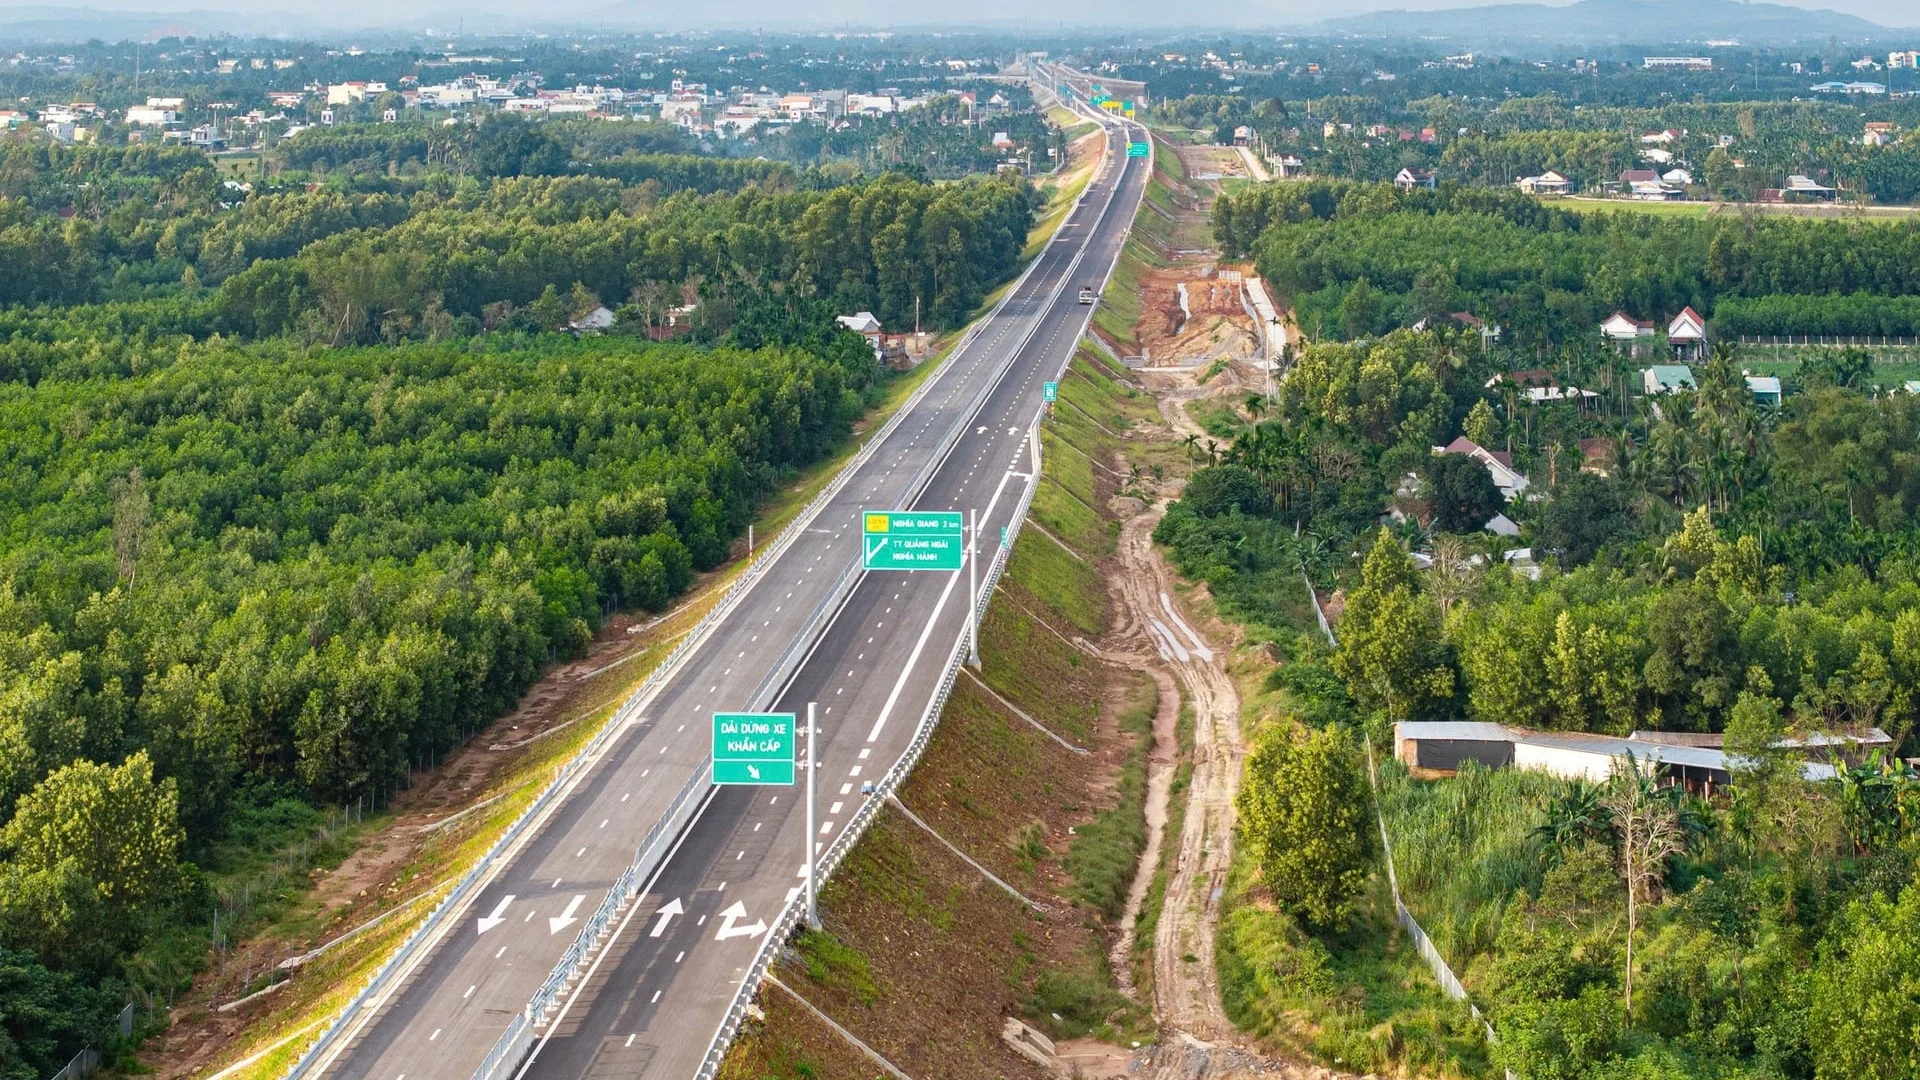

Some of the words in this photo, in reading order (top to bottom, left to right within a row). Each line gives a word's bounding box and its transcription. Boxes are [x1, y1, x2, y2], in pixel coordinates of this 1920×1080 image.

[917, 520, 939, 528] GIANG
[943, 520, 948, 528] 2
[893, 540, 902, 548] TT
[721, 719, 738, 734] DẢI
[773, 723, 786, 735] XE
[760, 737, 781, 752] CẤP
